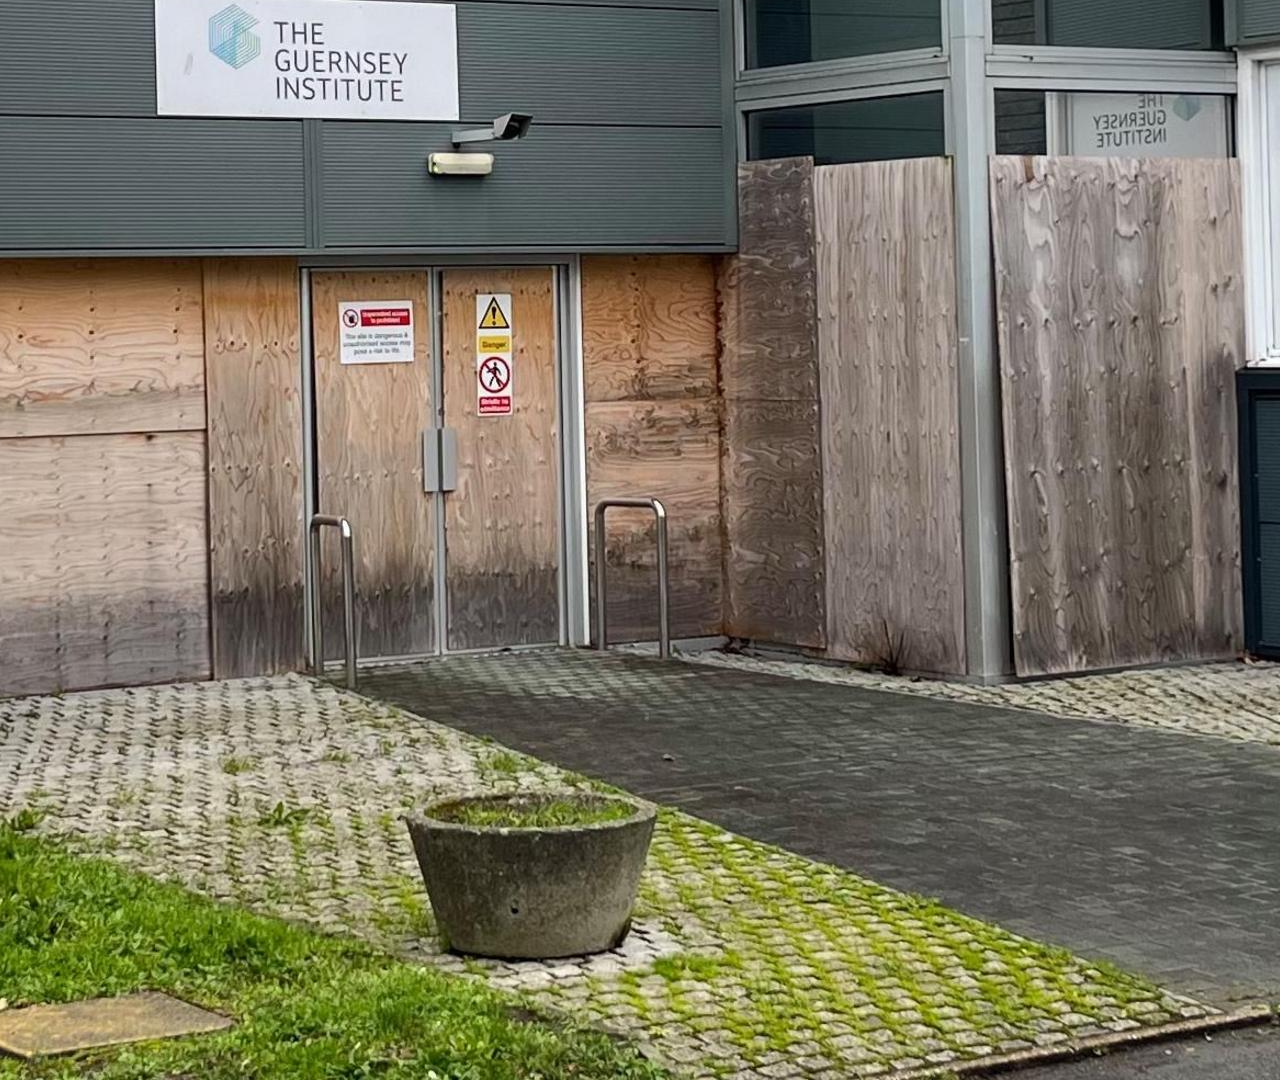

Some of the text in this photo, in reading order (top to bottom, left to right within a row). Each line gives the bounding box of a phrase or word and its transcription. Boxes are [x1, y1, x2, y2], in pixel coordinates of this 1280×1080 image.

[273, 21, 325, 45] THE
[275, 49, 408, 74] GUERNSEY
[276, 77, 404, 102] INSTITUTE
[482, 341, 506, 349] Danger
